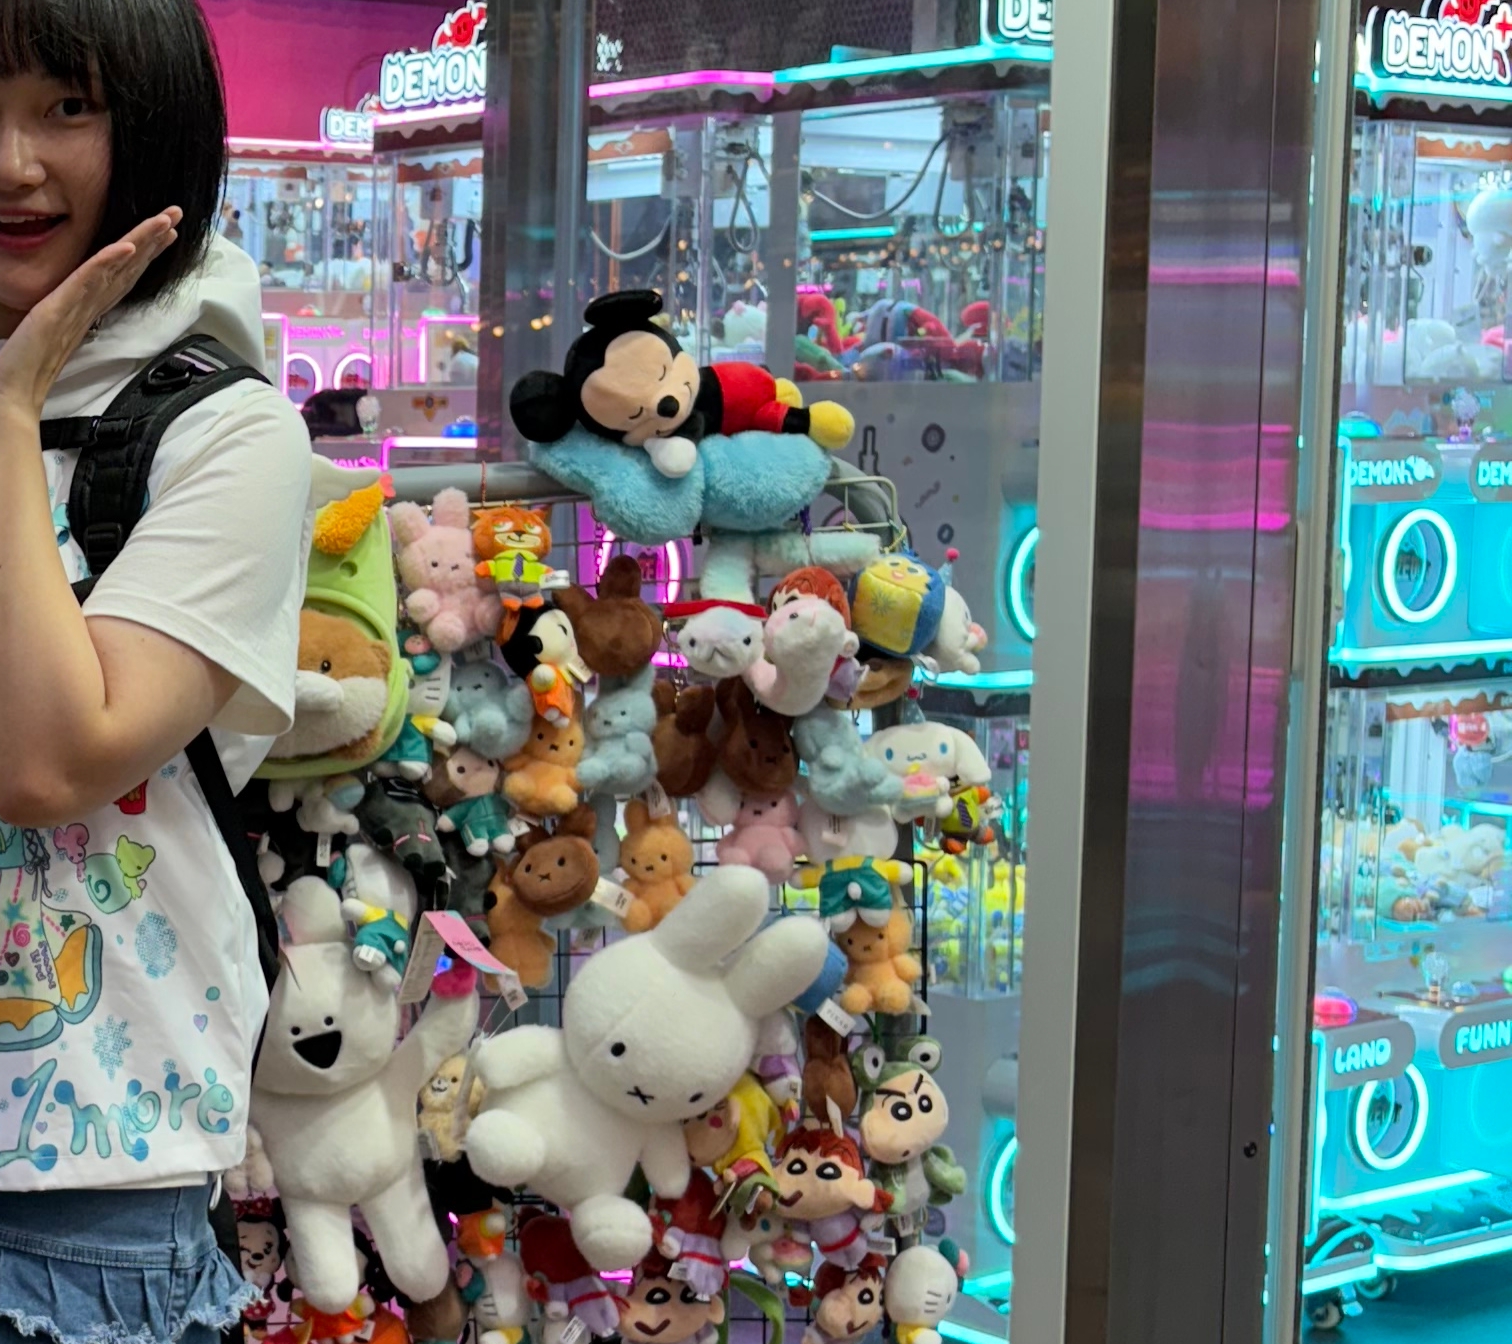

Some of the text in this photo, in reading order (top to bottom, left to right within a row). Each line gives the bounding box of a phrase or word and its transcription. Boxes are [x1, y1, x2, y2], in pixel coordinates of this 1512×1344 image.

[1386, 17, 1496, 76] DEMON
[384, 45, 487, 105] DEMON
[328, 112, 374, 140] DEM
[1350, 459, 1406, 487] DEMON
[1477, 459, 1512, 487] DEM
[1454, 1018, 1512, 1055] FUNN
[1333, 1037, 1392, 1075] LAND
